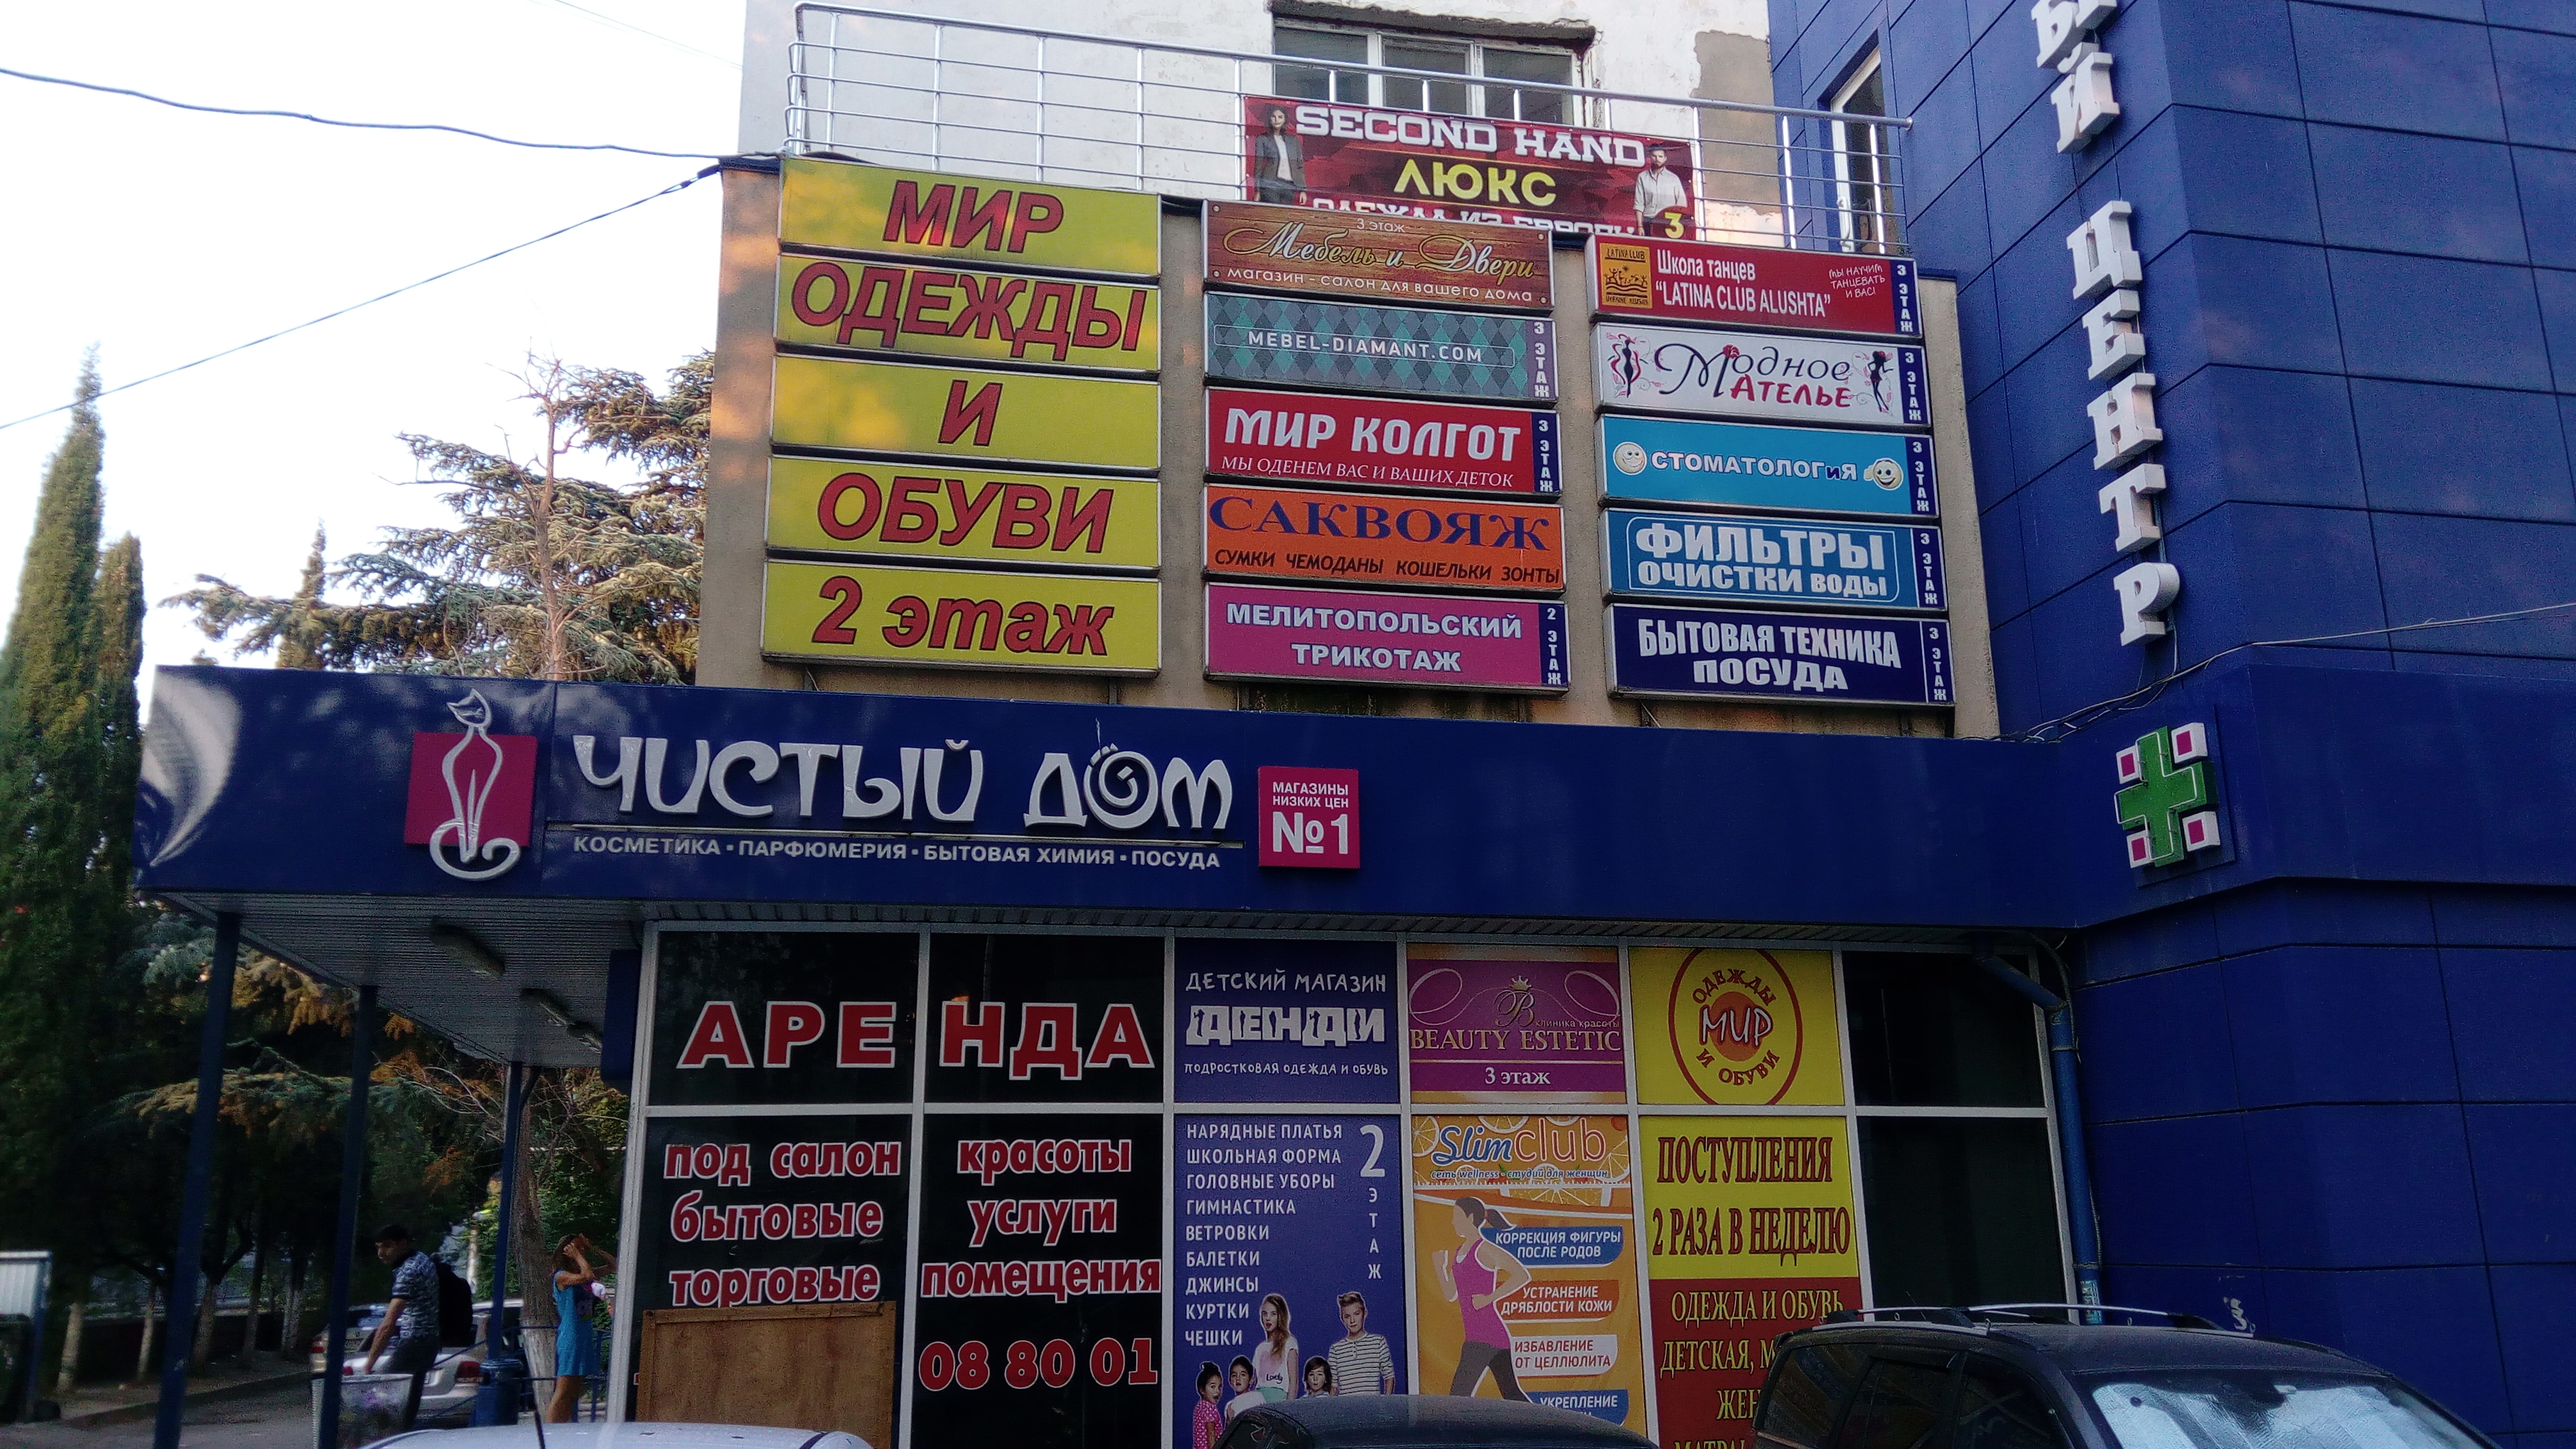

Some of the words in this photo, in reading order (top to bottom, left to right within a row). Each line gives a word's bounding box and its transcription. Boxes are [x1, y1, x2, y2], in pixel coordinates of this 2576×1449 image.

[1295, 105, 1497, 153] SECOND
[1514, 127, 1645, 167] HAND
[1394, 158, 1557, 207] ЛЮКС
[883, 180, 1063, 254] МИР
[1356, 218, 1365, 230] 3
[1369, 221, 1406, 233] этаж
[1665, 212, 1684, 238] 3
[1223, 222, 1376, 265] Мебель
[1387, 249, 1403, 266] и
[1417, 234, 1534, 285] Двери
[1657, 249, 1703, 276] Школа
[1706, 256, 1756, 282] танцев
[1227, 267, 1304, 284] магазин
[1320, 275, 1376, 290] салон
[1380, 280, 1410, 293] для
[1415, 282, 1479, 300] вашего
[1484, 289, 1533, 302] дома
[1716, 288, 1757, 312] CLUB
[791, 261, 1148, 361] ОДЕЖДЫ
[1898, 282, 1913, 333] ЭТАЖ
[1248, 330, 1482, 363] MEBEL-DIAMANT.COM
[1534, 343, 1551, 398] ЭТАЖ
[1653, 342, 1851, 398] Модное
[937, 380, 1004, 446] И
[1906, 371, 1922, 422] ЭТАЖ
[1224, 407, 1336, 450] МИР
[1350, 417, 1521, 462] КОЛГОТ
[2065, 200, 2181, 647] ЦЕНТР
[1221, 455, 1253, 471] МЫ
[1257, 458, 1331, 476] ОДЕНЕМ
[1336, 463, 1368, 479] ВАС
[1372, 466, 1385, 479] И
[1390, 467, 1454, 485] ВАШИХ
[1455, 470, 1514, 488] ДЕТОК
[1540, 439, 1554, 493] ЭТАЖ
[1913, 461, 1930, 513] ЭТАЖ
[818, 472, 1114, 553] ОБУВИ
[1209, 496, 1551, 551] САКВОЯЖ
[1635, 522, 1885, 570] ФИЛЬТРЫ
[1214, 549, 1275, 568] СУМКИ
[1286, 553, 1384, 575] ЧЕМОДАНЫ
[1396, 560, 1492, 582] КОШЕЛЬКИ
[1501, 566, 1560, 584] ЗОНТЫ
[1639, 560, 1803, 593] ОЧИСТКИ
[1810, 572, 1887, 599] ВОДЫ
[1922, 552, 1938, 605] ЭТАЖ
[811, 576, 863, 645] 2
[882, 595, 1115, 656] этаж
[1226, 602, 1522, 639] МЕЛИТОПОЛЬСКИЙ
[1546, 608, 1557, 621] 2
[1291, 643, 1462, 673] ТРИКОТАЖ
[1547, 630, 1562, 685] ЭТАЖ
[1638, 619, 1775, 658] БЫТОВАЯ
[1780, 625, 1902, 669] ТЕХНИКА
[1694, 657, 1848, 693] ПОСУДА
[1931, 647, 1947, 701] ЭТАЖ
[572, 735, 983, 822] ЧИСТЫЙ
[1023, 744, 1233, 831] ДОМ
[1272, 781, 1349, 796] МАГАЗИНЫ
[1272, 795, 1322, 809] НИЗКИХ
[1324, 797, 1349, 811] ЦЕН
[574, 835, 721, 856] КОСМЕТИКА
[738, 839, 907, 860] ПАРФЮМЕРИЯ
[924, 844, 1031, 864] БЫТОВАЯ
[1036, 847, 1114, 866] ХИМИЯ
[1131, 851, 1221, 871] ПОСУДА
[1186, 969, 1286, 992] ДЕТСКИЙ
[1294, 973, 1387, 993] МАГАЗИН
[1693, 968, 1777, 1006] ОДЕЖДЫ
[1186, 1005, 1385, 1047] ДЕНДИ
[1410, 1029, 1509, 1050] BEAUTY
[1520, 1031, 1621, 1051] ESTETIC
[1535, 1019, 1576, 1028] клиника
[1184, 1062, 1279, 1075] ПОДРОСТКОВАЯ
[1283, 1063, 1337, 1076] ОДЕЖДА
[1353, 1063, 1388, 1076] ОБУВЬ
[1485, 1067, 1496, 1085] 3
[1501, 1071, 1551, 1085] этаж
[1696, 1049, 1715, 1068] И
[1719, 1050, 1780, 1086] ОБУВИ
[1186, 1124, 1276, 1141] НАРЯДНЫЕ
[1281, 1124, 1343, 1139] ПЛАТЬЯ
[1359, 1124, 1386, 1177] 2
[664, 1142, 751, 1187] под
[770, 1141, 902, 1179] салон
[957, 1139, 1132, 1186] красоты
[1186, 1148, 1277, 1164] ШКОЛЬНАЯ
[1282, 1148, 1341, 1164] ФОРМА
[1432, 1170, 1456, 1179] сеть
[1458, 1168, 1499, 1179] wellness
[1507, 1168, 1544, 1180] студий
[1546, 1170, 1563, 1180] для
[1566, 1170, 1608, 1180] женщин
[1657, 1136, 1833, 1184] ПОСТУПЛЕНИЯ
[1186, 1174, 1274, 1189] ГОЛОВНЫЕ
[1279, 1174, 1335, 1189] УБОРЫ
[670, 1190, 883, 1242] бытовые
[967, 1198, 1117, 1248] услуги
[1186, 1199, 1296, 1215] ГИМНАСТИКА
[1186, 1225, 1269, 1241] ВЕТРОВКИ
[1367, 1187, 1382, 1280] ЭТАЖ
[1495, 1231, 1566, 1247] КОРРЕКЦИЯ
[1570, 1230, 1621, 1245] ФИГУРЫ
[1652, 1208, 1663, 1256] 2
[1669, 1206, 1723, 1256] РАЗА
[1728, 1208, 1743, 1255] В
[1749, 1206, 1850, 1267] НЕДЕЛЮ
[1186, 1251, 1260, 1267] БАЛЕТКИ
[1517, 1246, 1557, 1259] ПОСЛЕ
[1561, 1246, 1601, 1259] РОДОВ
[669, 1264, 881, 1308] торговые
[920, 1258, 1162, 1303] помещения
[1185, 1276, 1259, 1295] ДЖИНСЫ
[1523, 1285, 1599, 1299] УСТРАНЕНИЕ
[1186, 1303, 1249, 1319] КУРТКИ
[1500, 1300, 1574, 1316] ДРЯБЛОСТИ
[1577, 1300, 1613, 1312] КОЖИ
[1671, 1290, 1760, 1329] ОДЕЖДА
[1762, 1290, 1777, 1319] И
[1185, 1330, 1242, 1346] ЧЕШКИ
[1514, 1339, 1594, 1353] ИЗБАВЛЕНИЕ
[918, 1340, 990, 1391] 08
[1004, 1338, 1076, 1389] 80
[1089, 1337, 1158, 1387] 01
[1515, 1356, 1531, 1369] ОТ
[1534, 1355, 1611, 1370] ЦЕЛЛЮЛИТА
